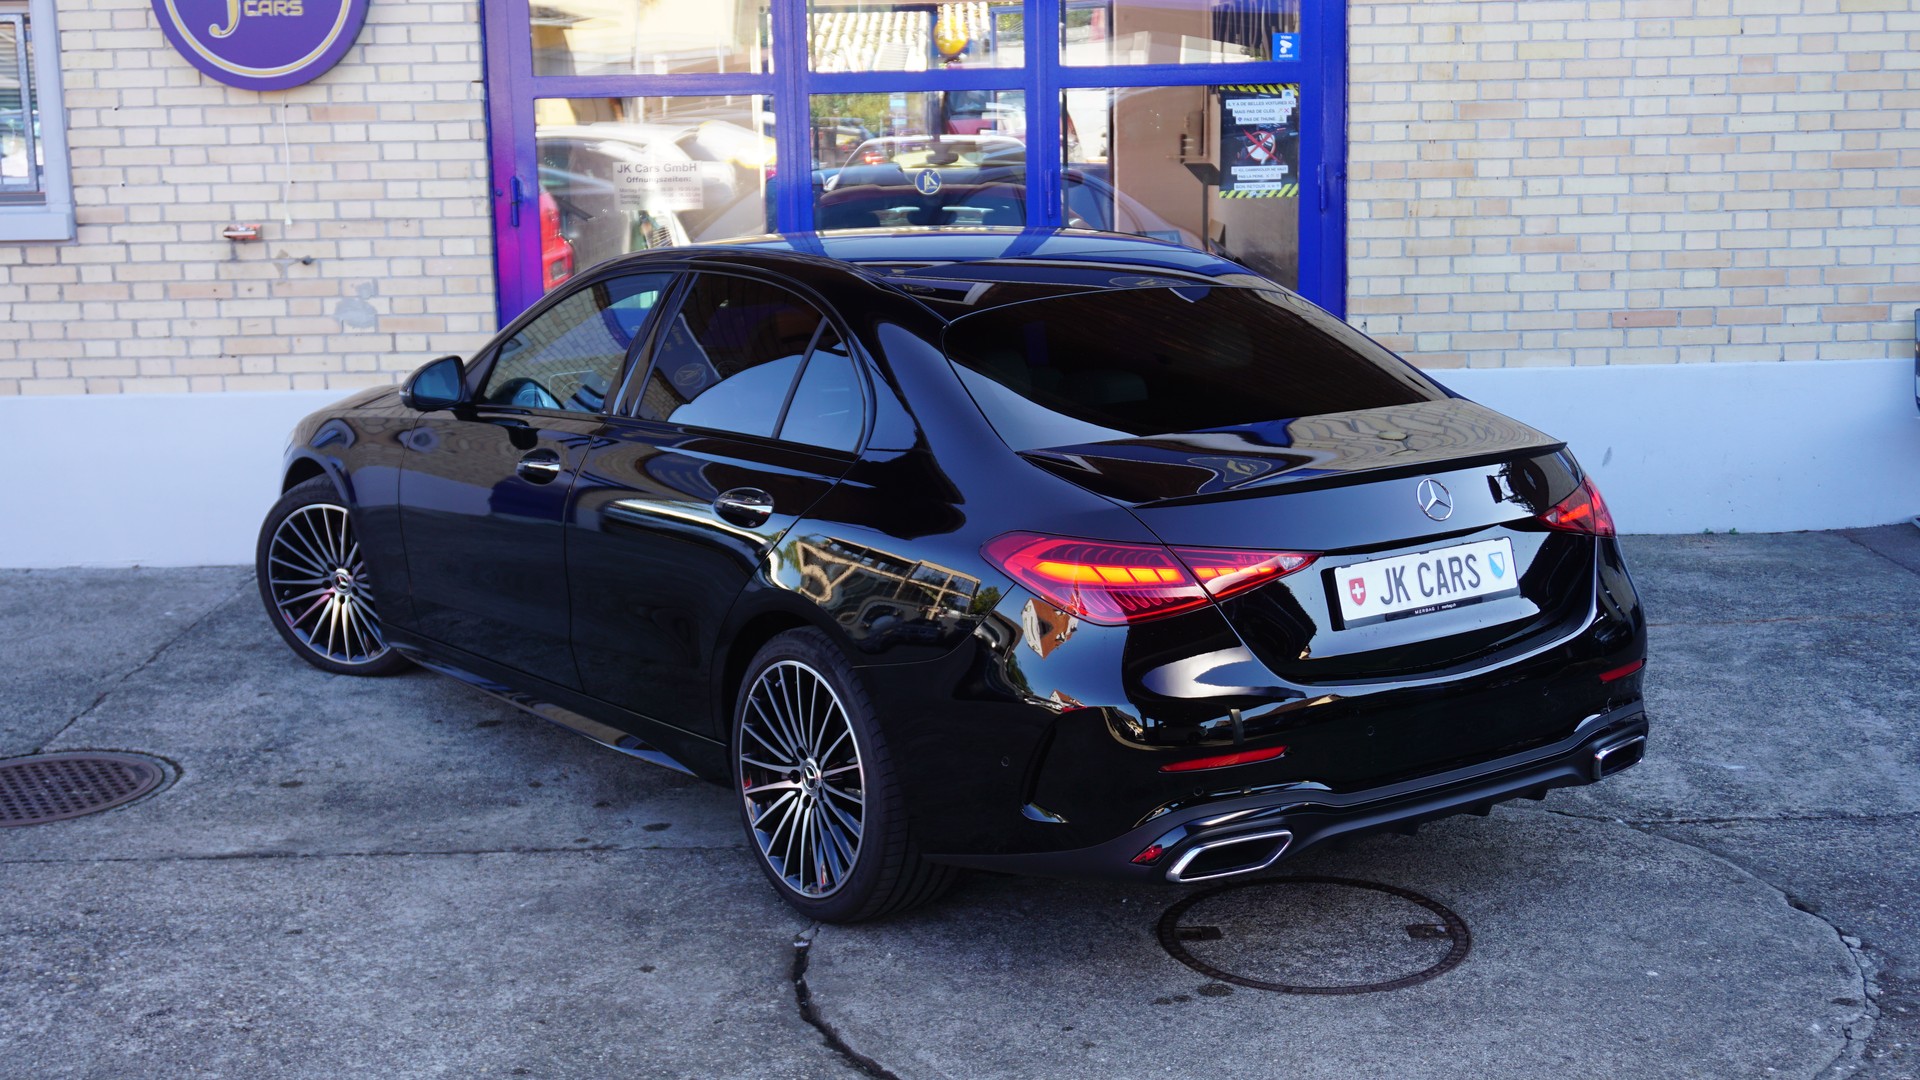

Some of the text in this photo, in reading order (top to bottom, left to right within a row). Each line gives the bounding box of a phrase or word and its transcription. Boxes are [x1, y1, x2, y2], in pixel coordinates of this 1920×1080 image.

[243, 0, 304, 16] CARS
[617, 162, 697, 174] JK Cars GmbH
[1380, 553, 1481, 605] JK CARS
